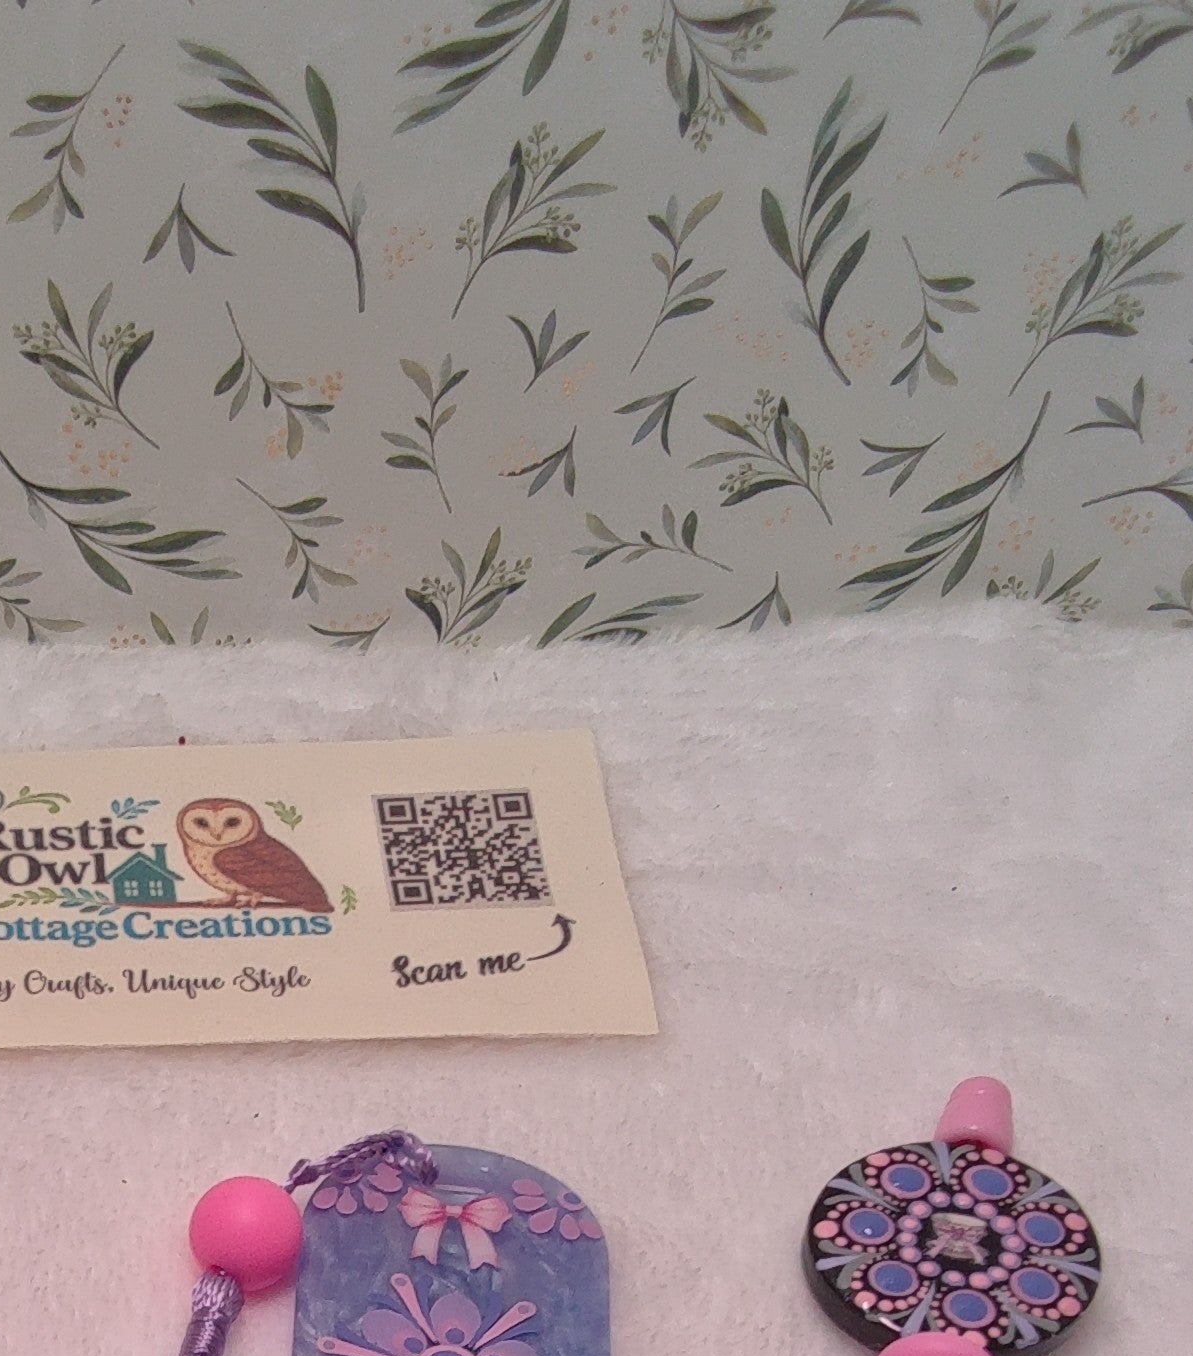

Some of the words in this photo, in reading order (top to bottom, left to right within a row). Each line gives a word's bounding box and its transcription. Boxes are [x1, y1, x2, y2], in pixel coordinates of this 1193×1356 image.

[123, 911, 333, 939] Creations
[122, 968, 226, 999] Unique
[233, 965, 311, 997] Style
[392, 955, 468, 988] Scan
[478, 952, 526, 976] me
